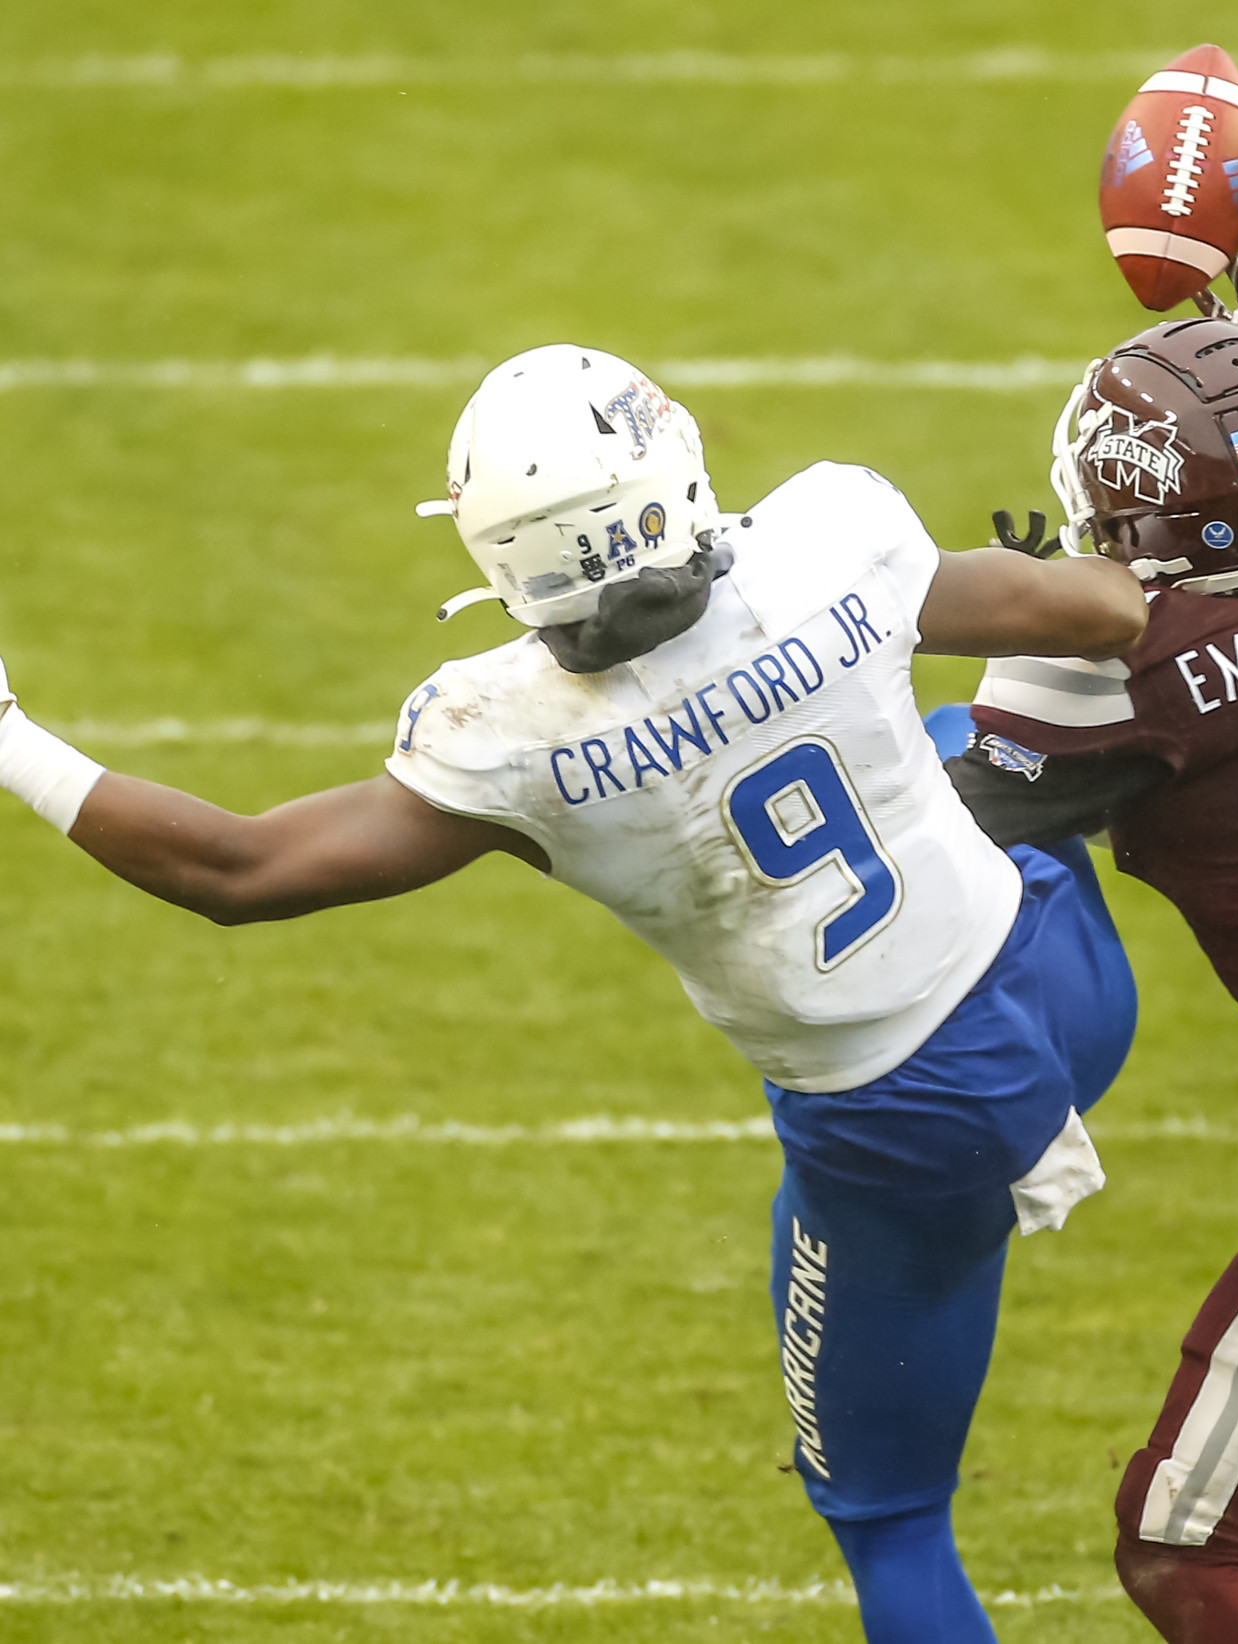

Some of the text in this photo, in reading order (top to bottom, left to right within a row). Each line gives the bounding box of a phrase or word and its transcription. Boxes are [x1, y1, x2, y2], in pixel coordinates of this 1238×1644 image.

[1102, 434, 1163, 474] STATE
[577, 533, 592, 555] 9
[605, 518, 638, 561] A
[616, 554, 636, 571] P6
[550, 591, 893, 806] CRAWFORD JR.
[720, 732, 905, 973] 9
